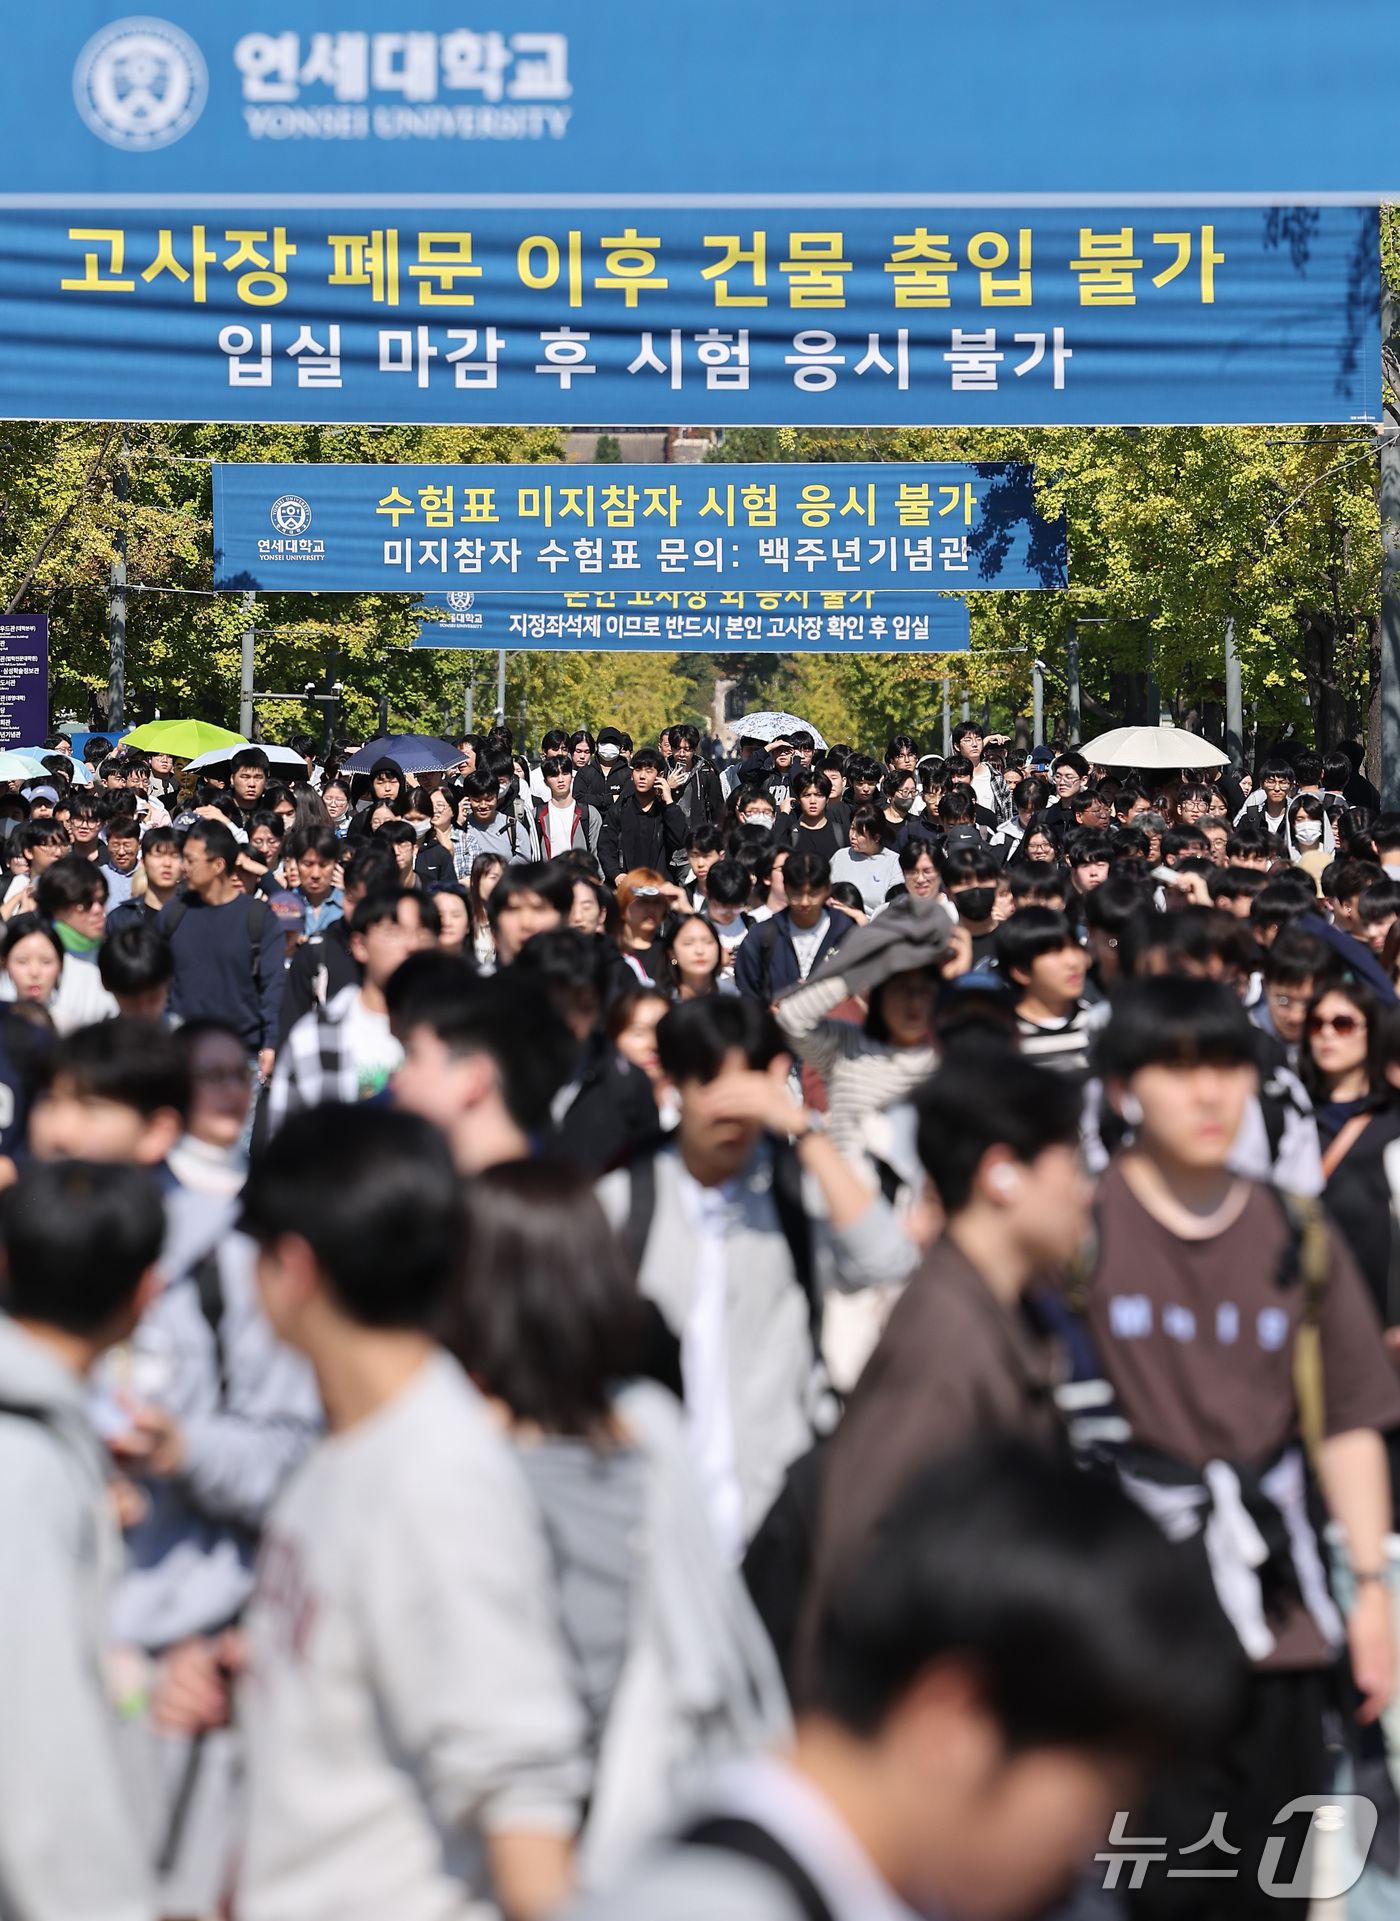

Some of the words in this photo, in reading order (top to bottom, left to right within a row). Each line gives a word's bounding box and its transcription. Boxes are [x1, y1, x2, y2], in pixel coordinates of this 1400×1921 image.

[234, 29, 572, 101] 연세대학교
[244, 105, 369, 139] YONSEI
[373, 105, 571, 139] UNIVERSITY
[61, 225, 297, 306] 고사장
[328, 229, 482, 306] 폐문
[517, 229, 668, 307] 이후
[700, 231, 852, 308] 건물
[884, 228, 1032, 307] 출입
[1070, 225, 1224, 305] 불가
[218, 324, 342, 387] 입실
[379, 326, 505, 388] 마감
[536, 327, 596, 389] 후
[627, 329, 749, 390] 시험
[784, 329, 909, 392] 응시
[943, 327, 1072, 390] 불가
[376, 485, 499, 527] 수험표
[519, 485, 682, 527] 미지참자
[699, 484, 776, 526] 시험
[796, 484, 875, 527] 응시
[895, 483, 977, 526] 불가
[258, 539, 325, 553] 연세대학교
[384, 538, 521, 573] 미지참자
[537, 538, 640, 573] 수험표
[657, 538, 738, 572] 문의:
[759, 536, 970, 572] 백주년기념관
[509, 613, 601, 638] 지정좌석제
[606, 615, 661, 638] 이므로
[666, 615, 720, 639] 반드시
[725, 616, 761, 639] 본인
[767, 616, 823, 640] 고사장
[827, 616, 863, 640] 확인
[869, 615, 888, 639] 후
[892, 616, 929, 640] 입실
